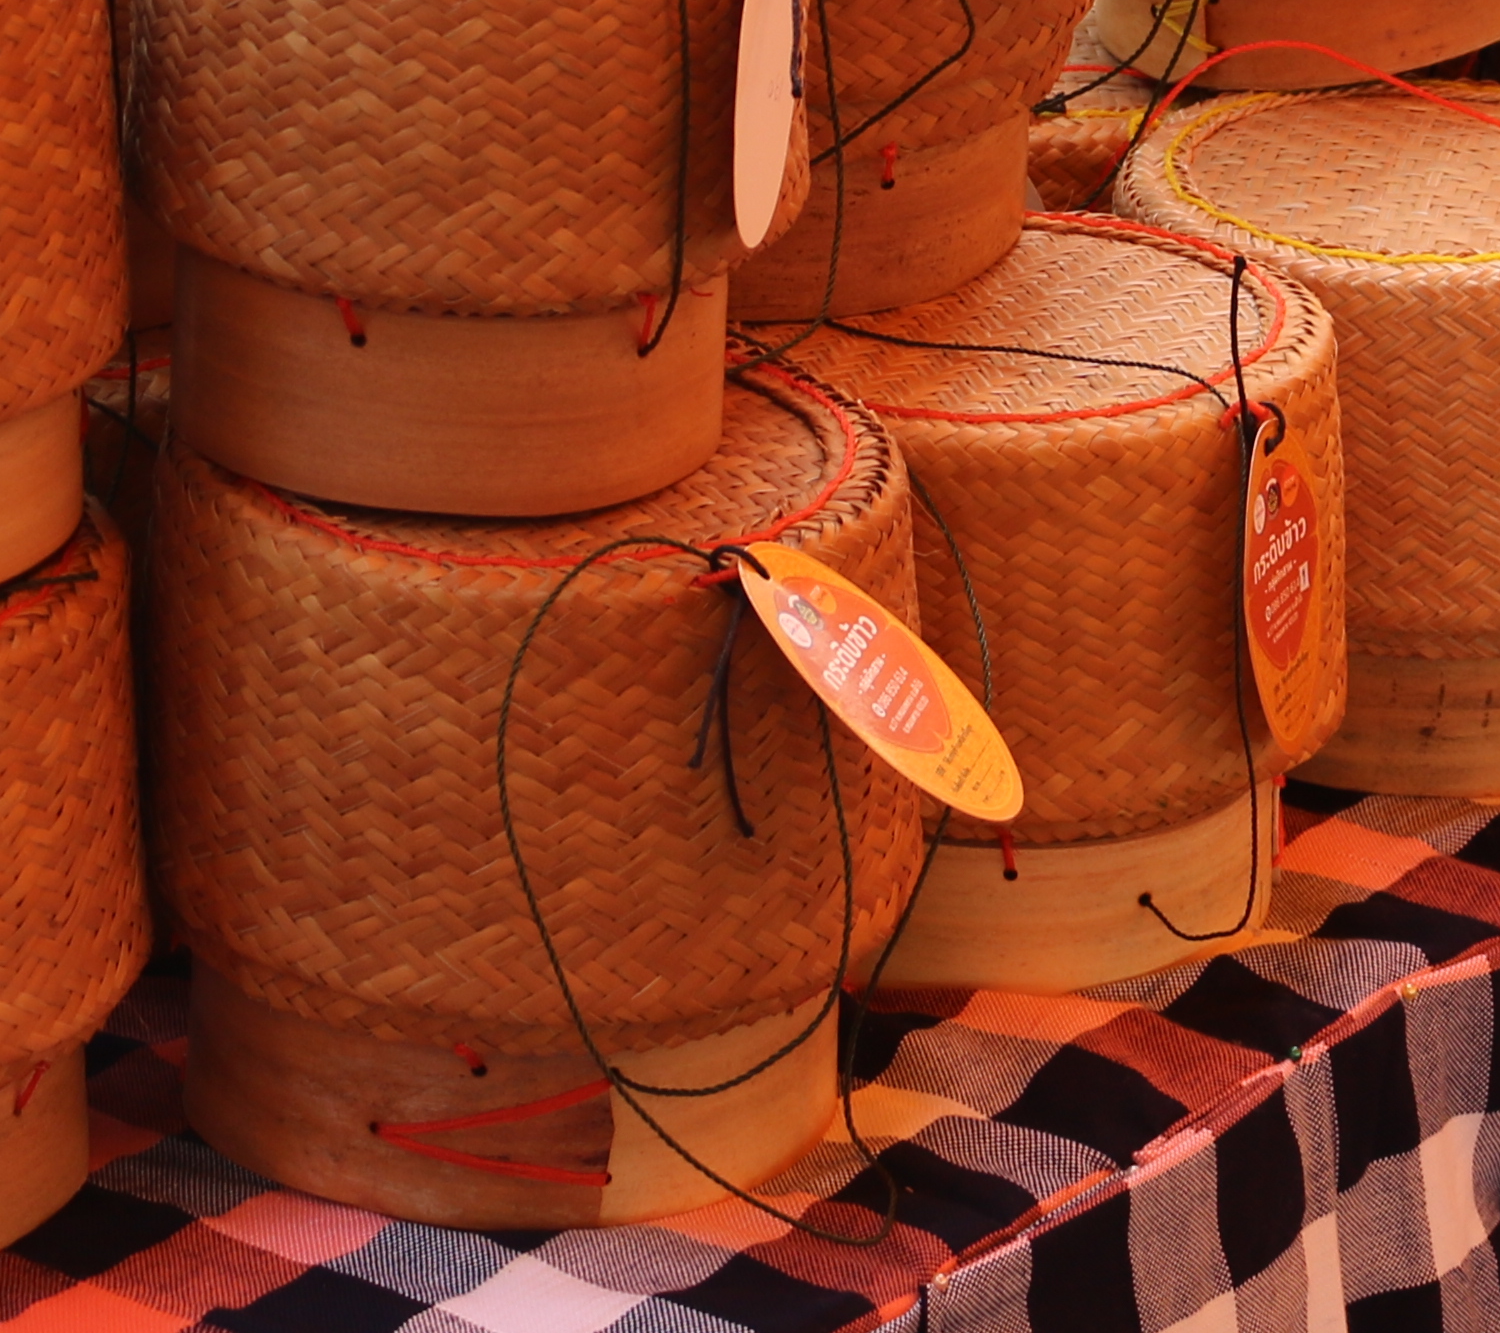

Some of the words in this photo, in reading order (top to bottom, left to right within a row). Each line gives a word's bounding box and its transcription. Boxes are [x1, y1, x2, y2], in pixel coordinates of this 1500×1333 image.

[1253, 516, 1307, 585] กระติบข้าว
[822, 615, 878, 692] กระติบข้าว
